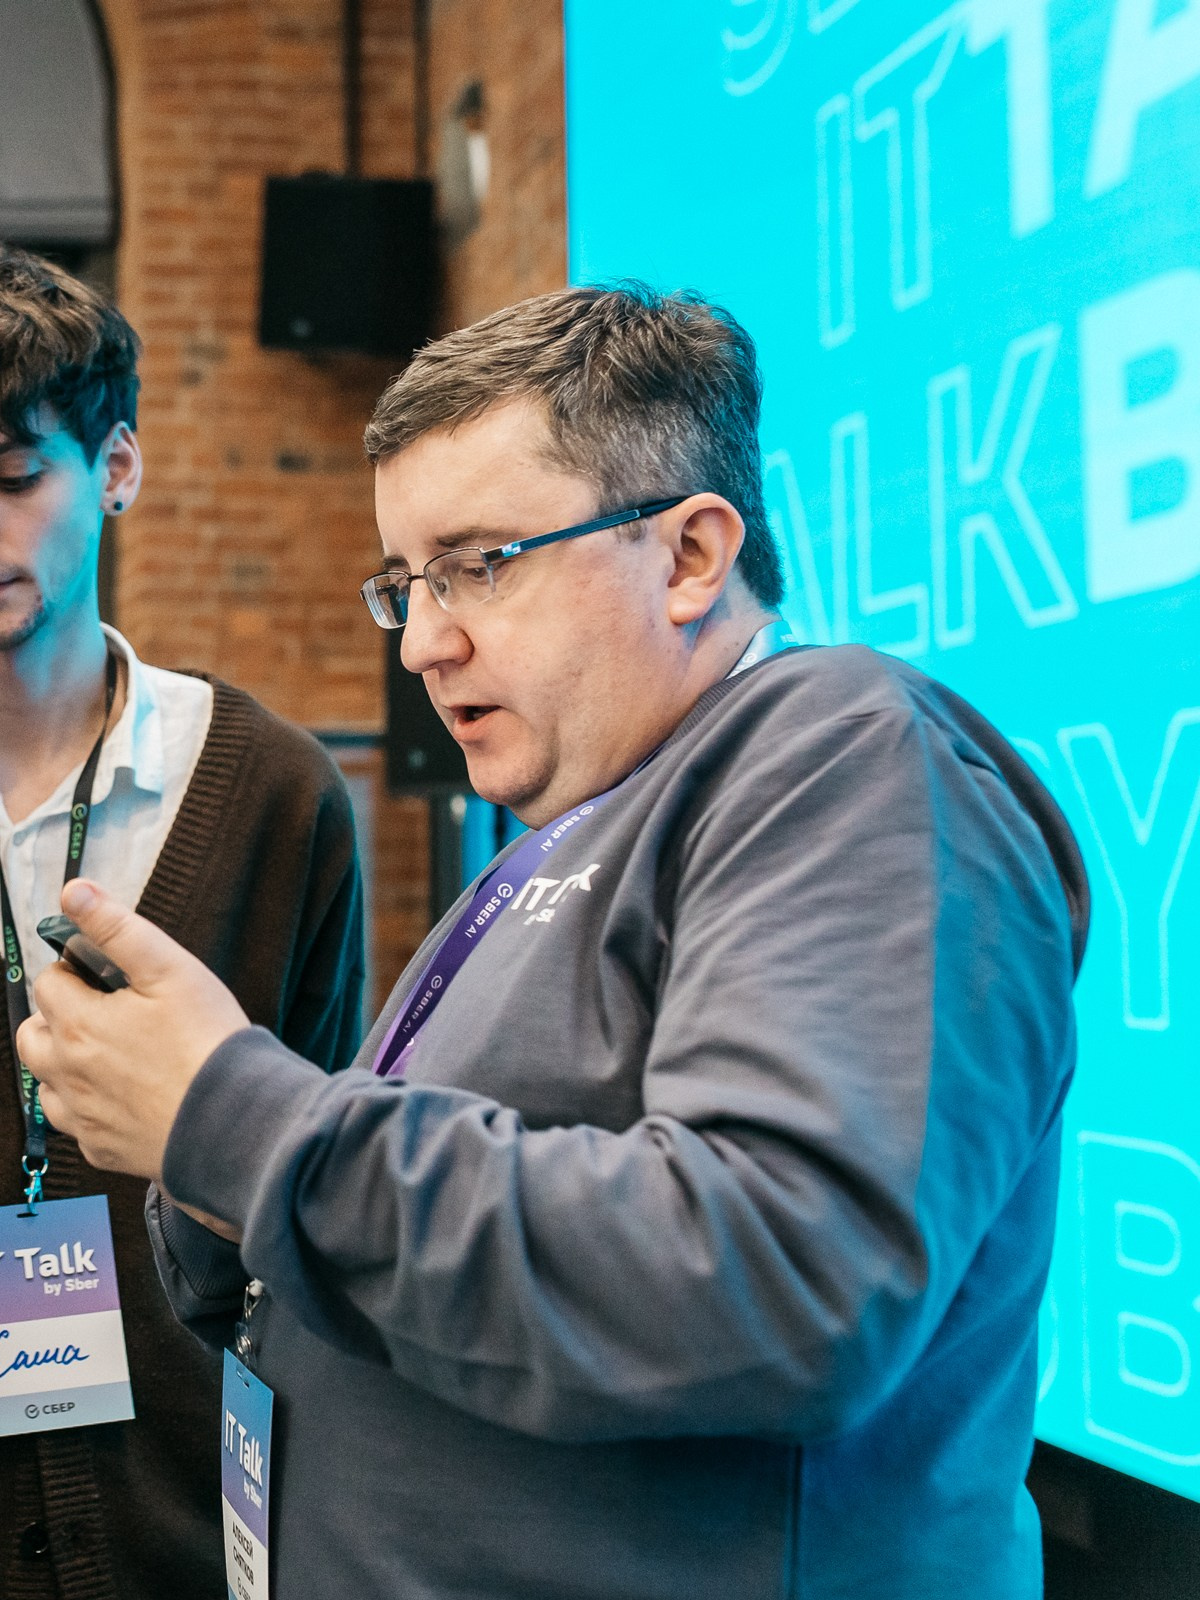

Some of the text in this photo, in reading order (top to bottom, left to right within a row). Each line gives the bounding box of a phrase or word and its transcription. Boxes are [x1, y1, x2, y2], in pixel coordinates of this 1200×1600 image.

[540, 815, 580, 852] SBER AI
[464, 896, 502, 939] SBER AI
[411, 989, 433, 1020] SBER
[13, 1241, 98, 1280] Talk
[43, 1276, 100, 1297] by Sber
[42, 1401, 76, 1415] СБЕР
[225, 1409, 264, 1488] IT Talk
